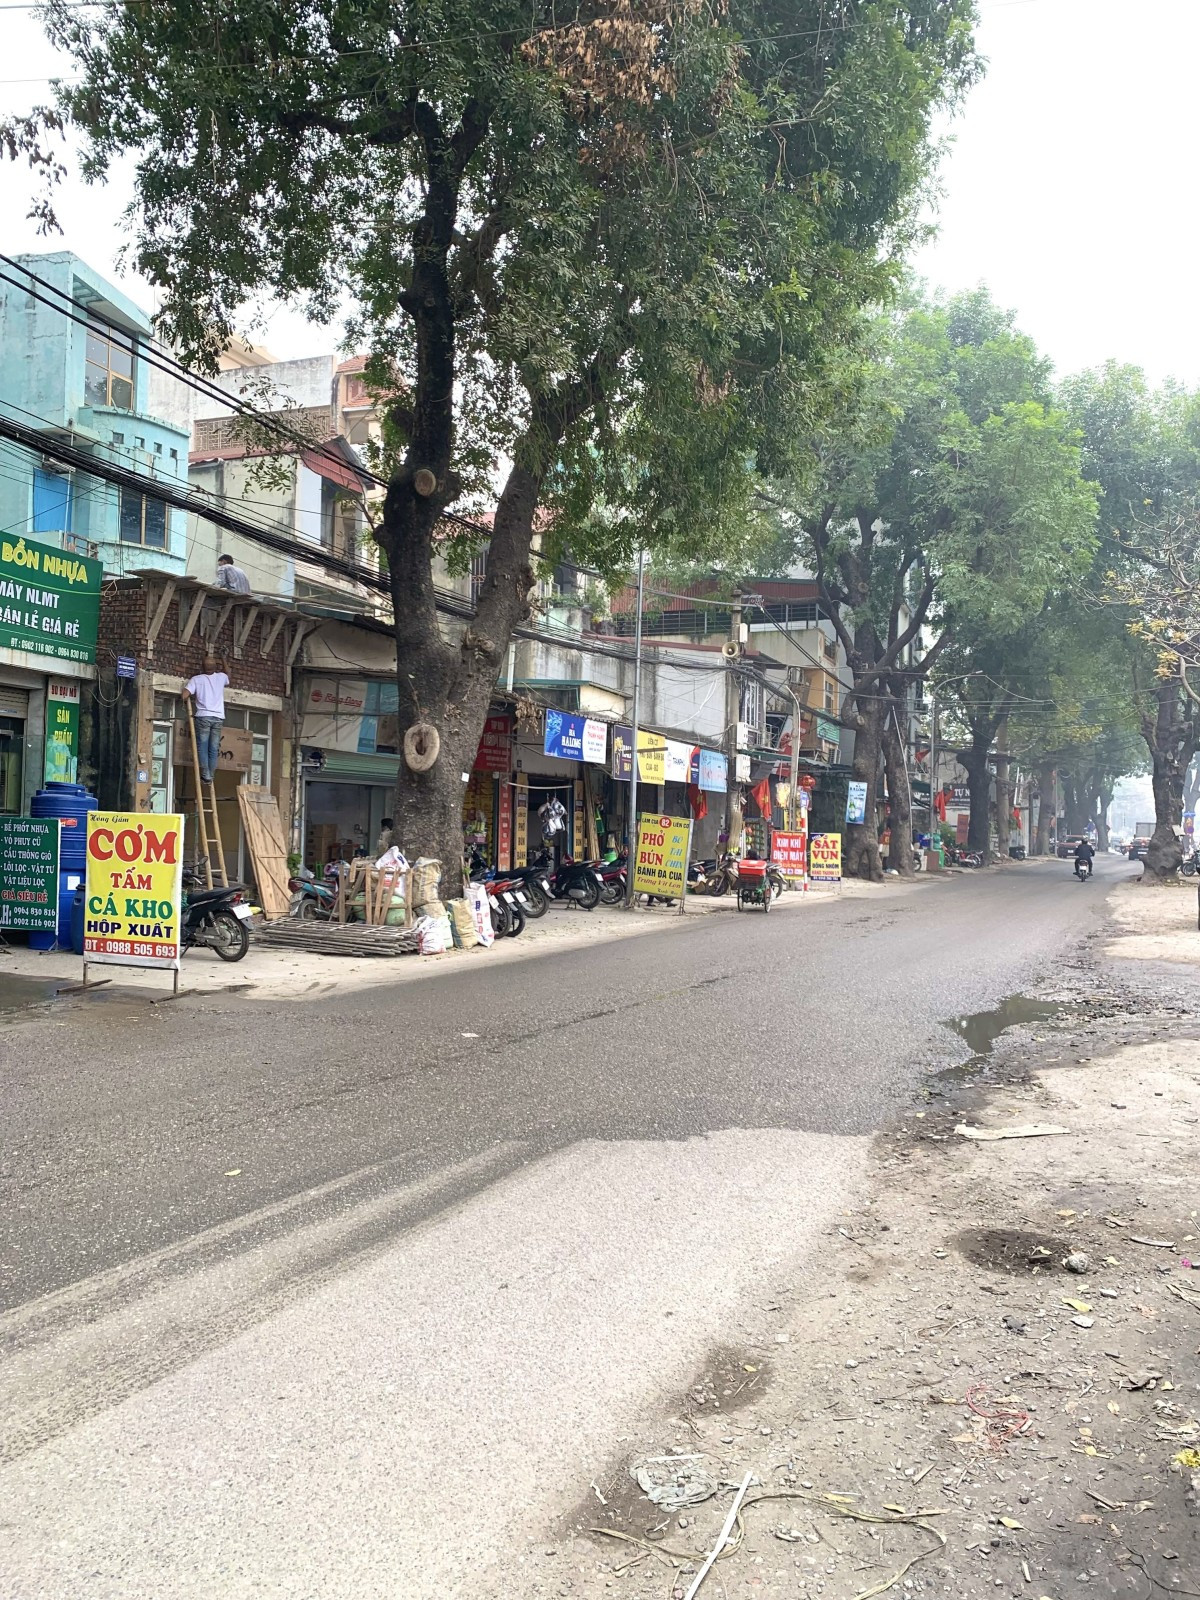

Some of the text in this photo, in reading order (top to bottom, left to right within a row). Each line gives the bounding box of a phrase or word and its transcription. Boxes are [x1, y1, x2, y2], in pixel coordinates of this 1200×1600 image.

[2, 538, 88, 584] BỒN NHỰA
[26, 588, 60, 609] NLMT
[25, 610, 39, 630] LẺ
[42, 617, 61, 634] GIÁ
[65, 619, 79, 639] RẺ
[57, 706, 70, 724] SẢN
[4, 819, 49, 836] BỂ PHỐT NHỰA
[661, 819, 670, 827] 82
[14, 837, 30, 846] PHUY
[89, 824, 177, 864] CƠM
[641, 830, 665, 847] PHỞ
[790, 837, 801, 848] KHÍ
[814, 835, 838, 849] SẮT
[640, 849, 663, 866] BÚN
[789, 851, 804, 861] MÁY
[812, 851, 839, 862] VỤN
[15, 864, 27, 874] LỌC
[31, 863, 44, 875] VẬT
[637, 865, 682, 881] BÁNH ĐA CUA
[4, 874, 45, 889] VẬT LIỆU LỌC
[110, 867, 152, 890] TẤM
[13, 906, 29, 916] 0964
[30, 908, 42, 916] 830
[43, 908, 55, 917] 816
[89, 892, 173, 919] CÁ KHO
[13, 917, 55, 928] 0902 116 902
[87, 919, 173, 938] HỘP XUẤT
[106, 941, 131, 953] 0988
[134, 943, 153, 956] 505
[156, 945, 175, 957] 693
